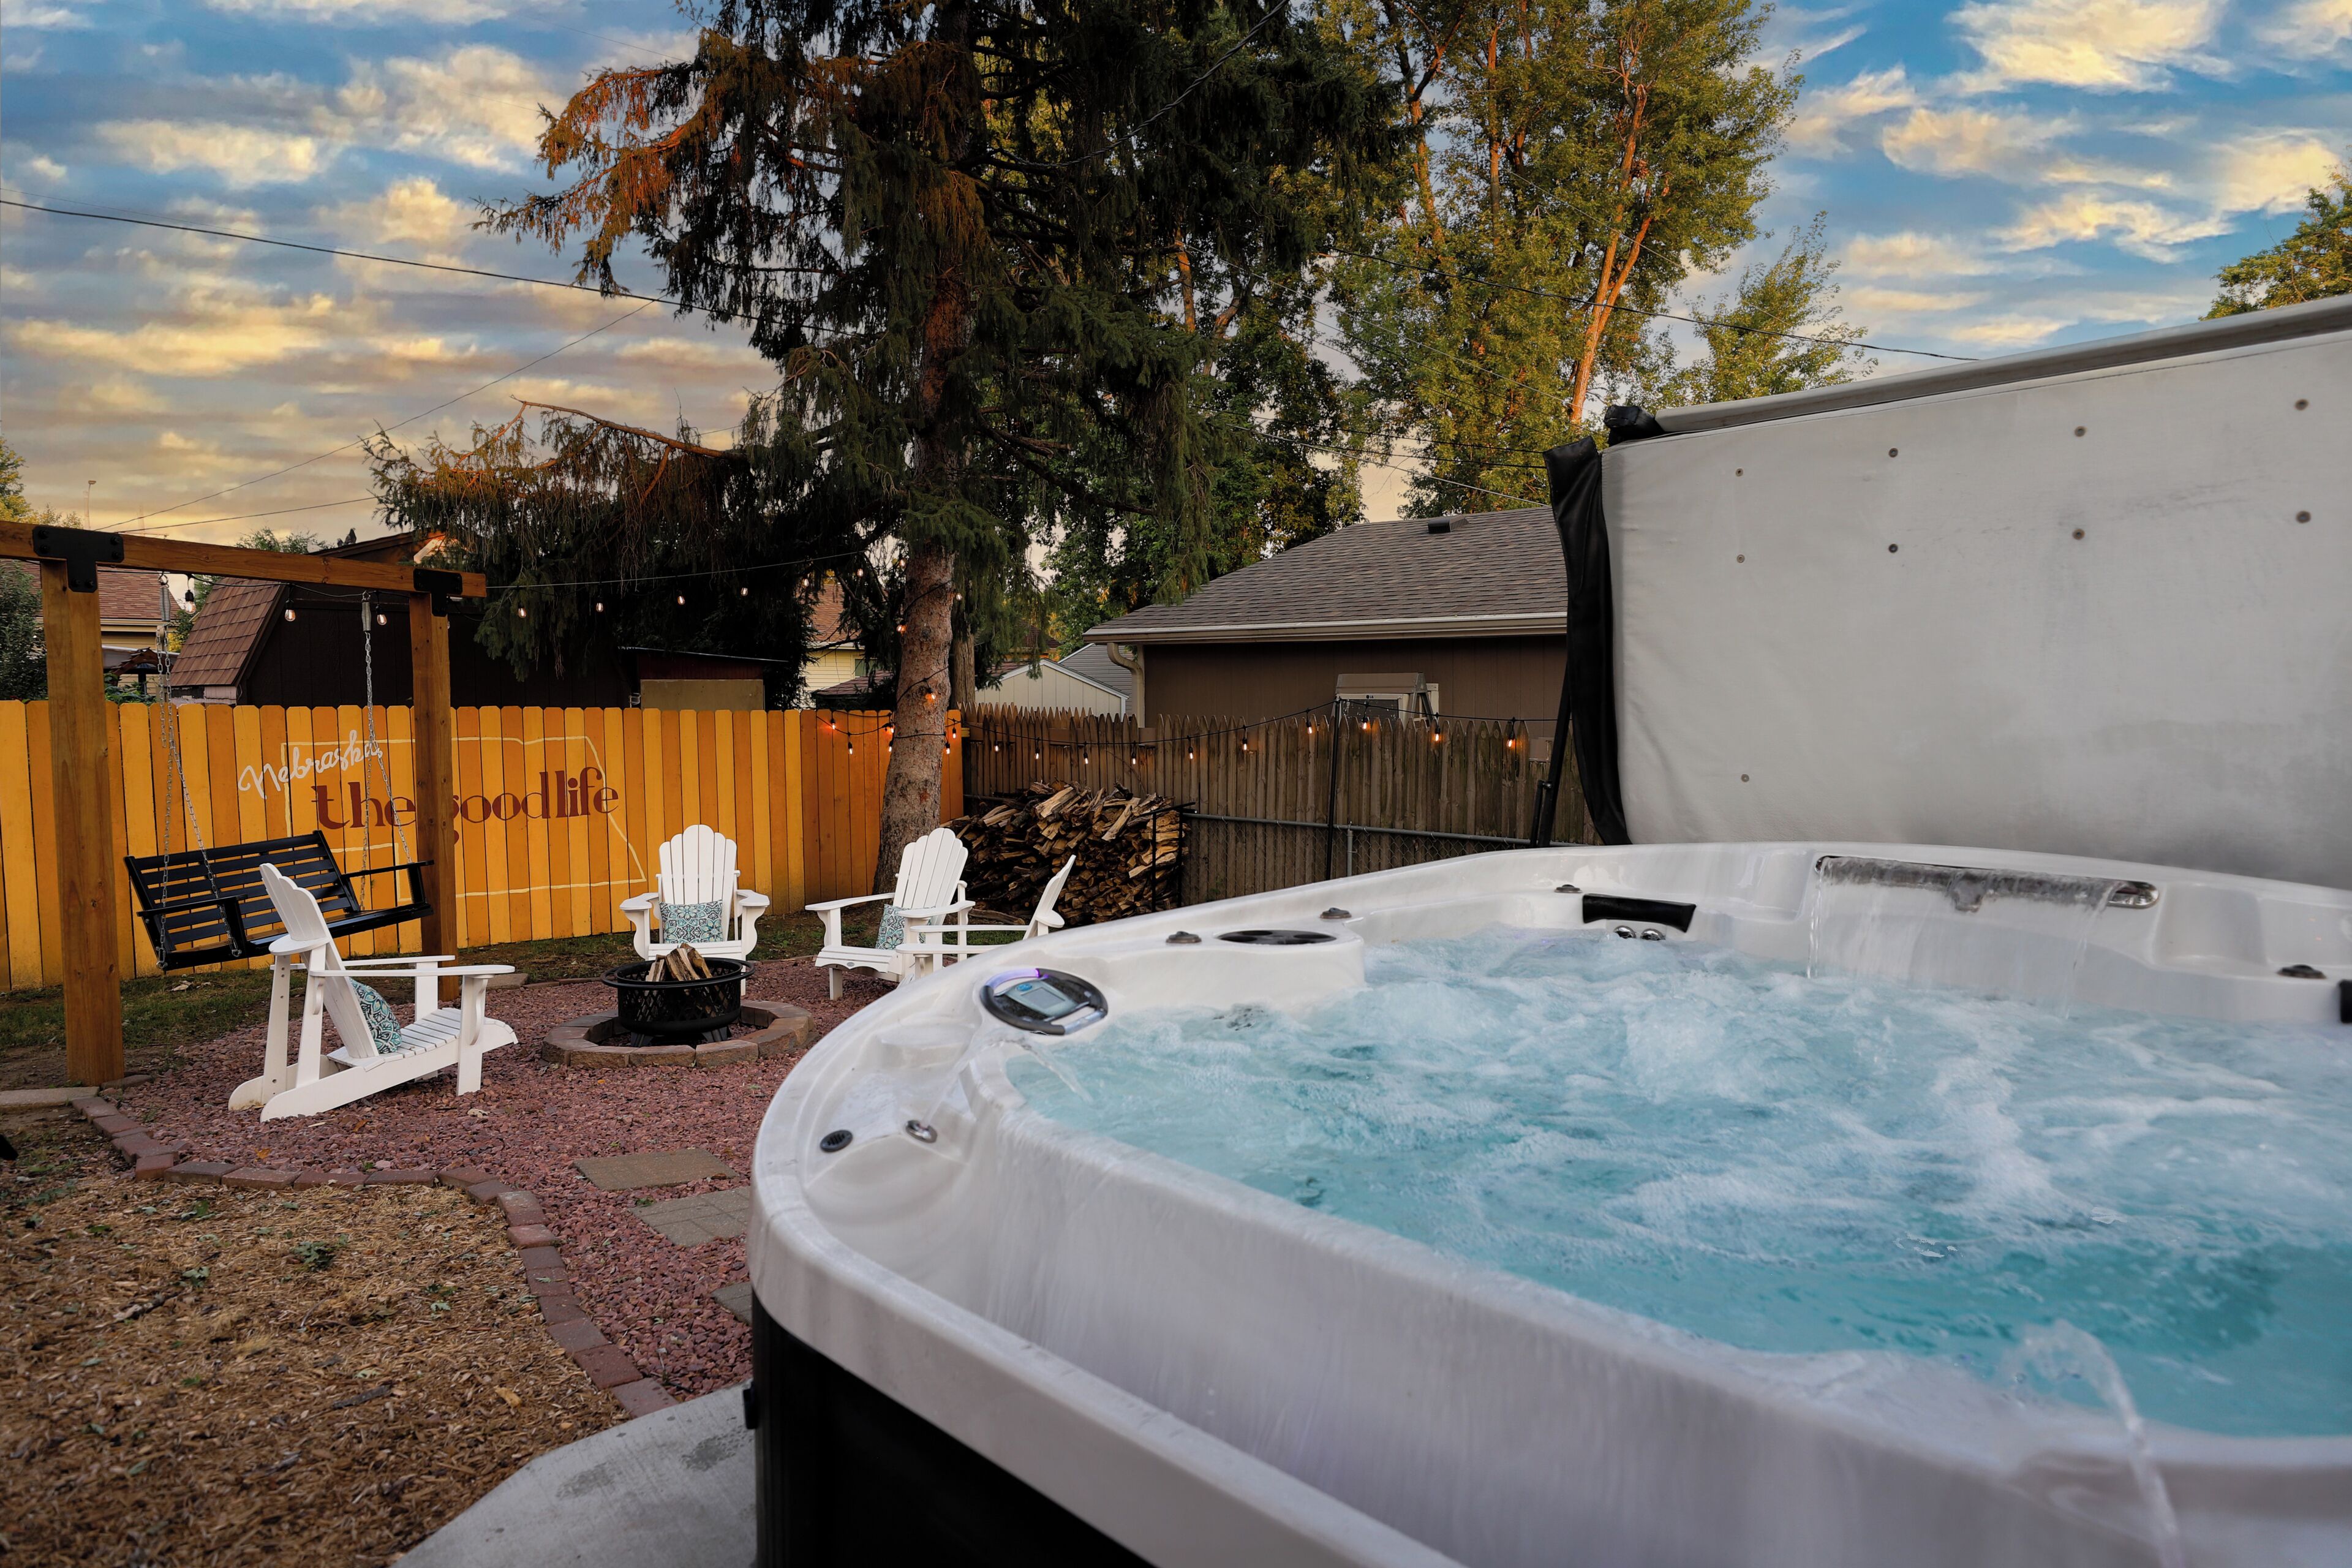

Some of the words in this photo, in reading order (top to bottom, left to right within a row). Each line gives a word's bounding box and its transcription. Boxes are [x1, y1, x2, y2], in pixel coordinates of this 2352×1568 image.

[311, 782, 416, 829] the
[453, 772, 551, 845] ood
[555, 767, 619, 818] life
